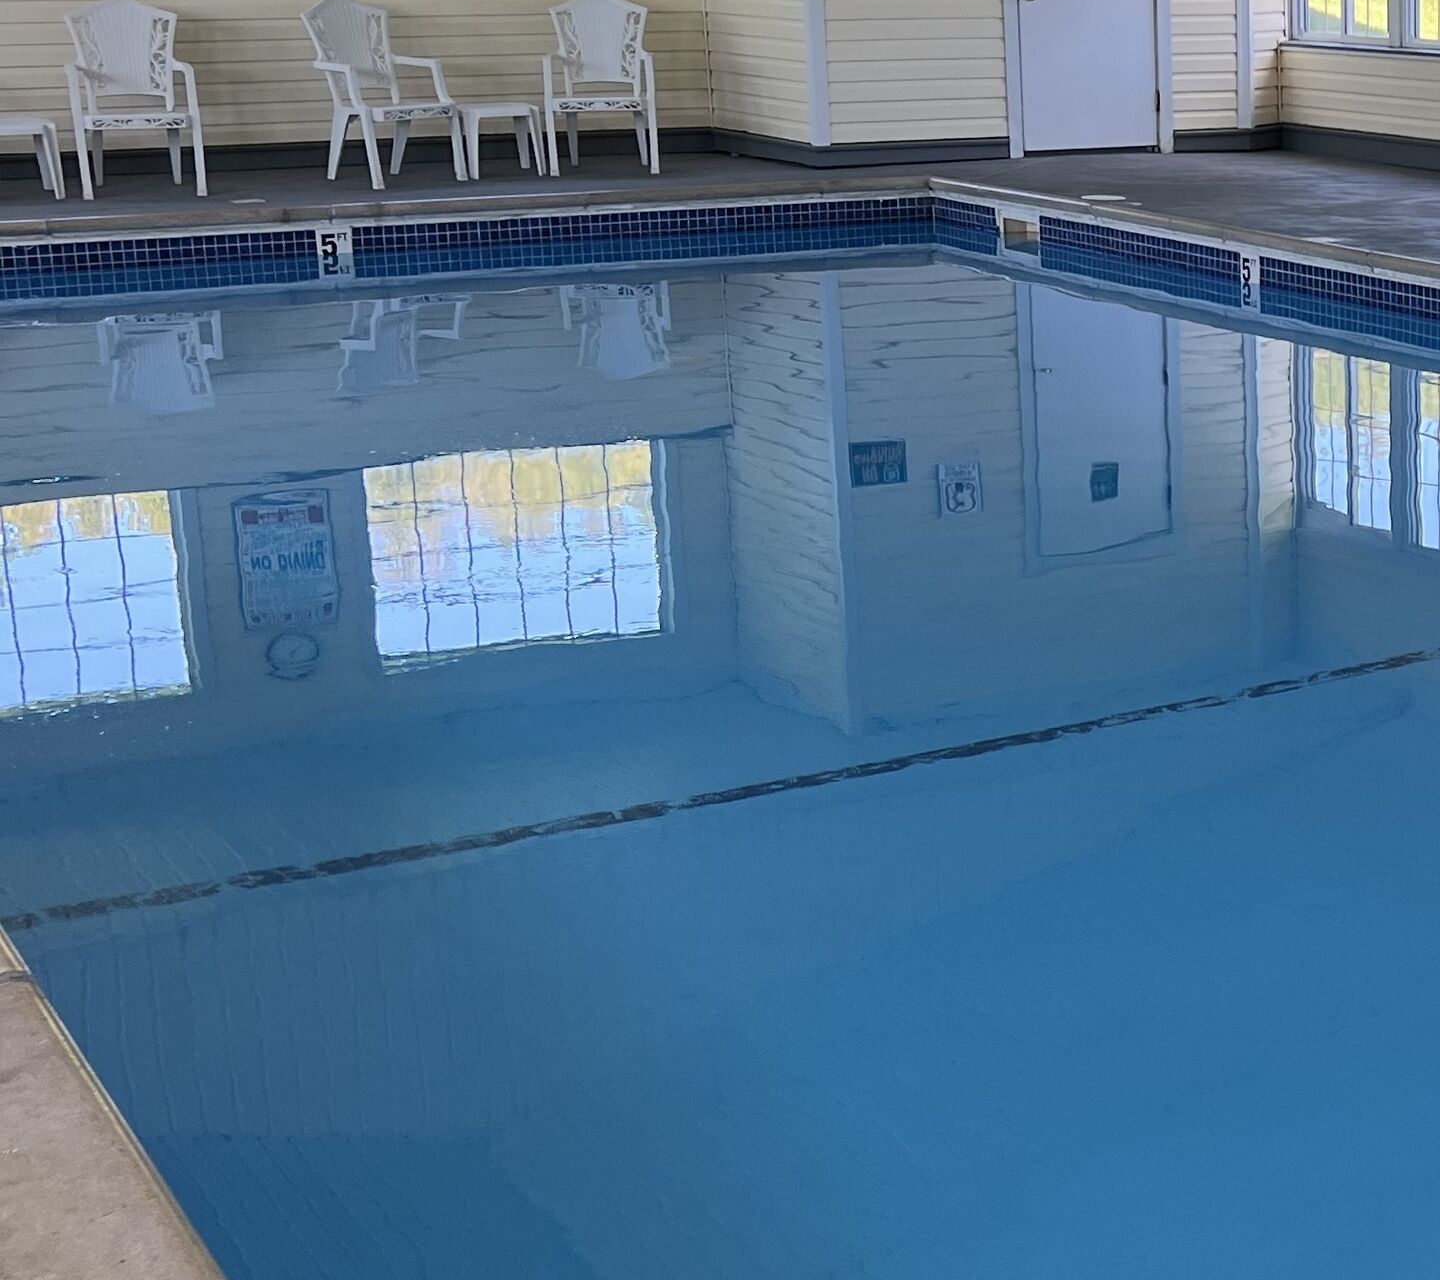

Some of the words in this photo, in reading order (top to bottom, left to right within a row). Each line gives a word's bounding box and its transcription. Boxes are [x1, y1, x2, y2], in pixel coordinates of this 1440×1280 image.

[320, 233, 338, 257] 5
[336, 232, 348, 241] FT
[1242, 257, 1251, 282] 5
